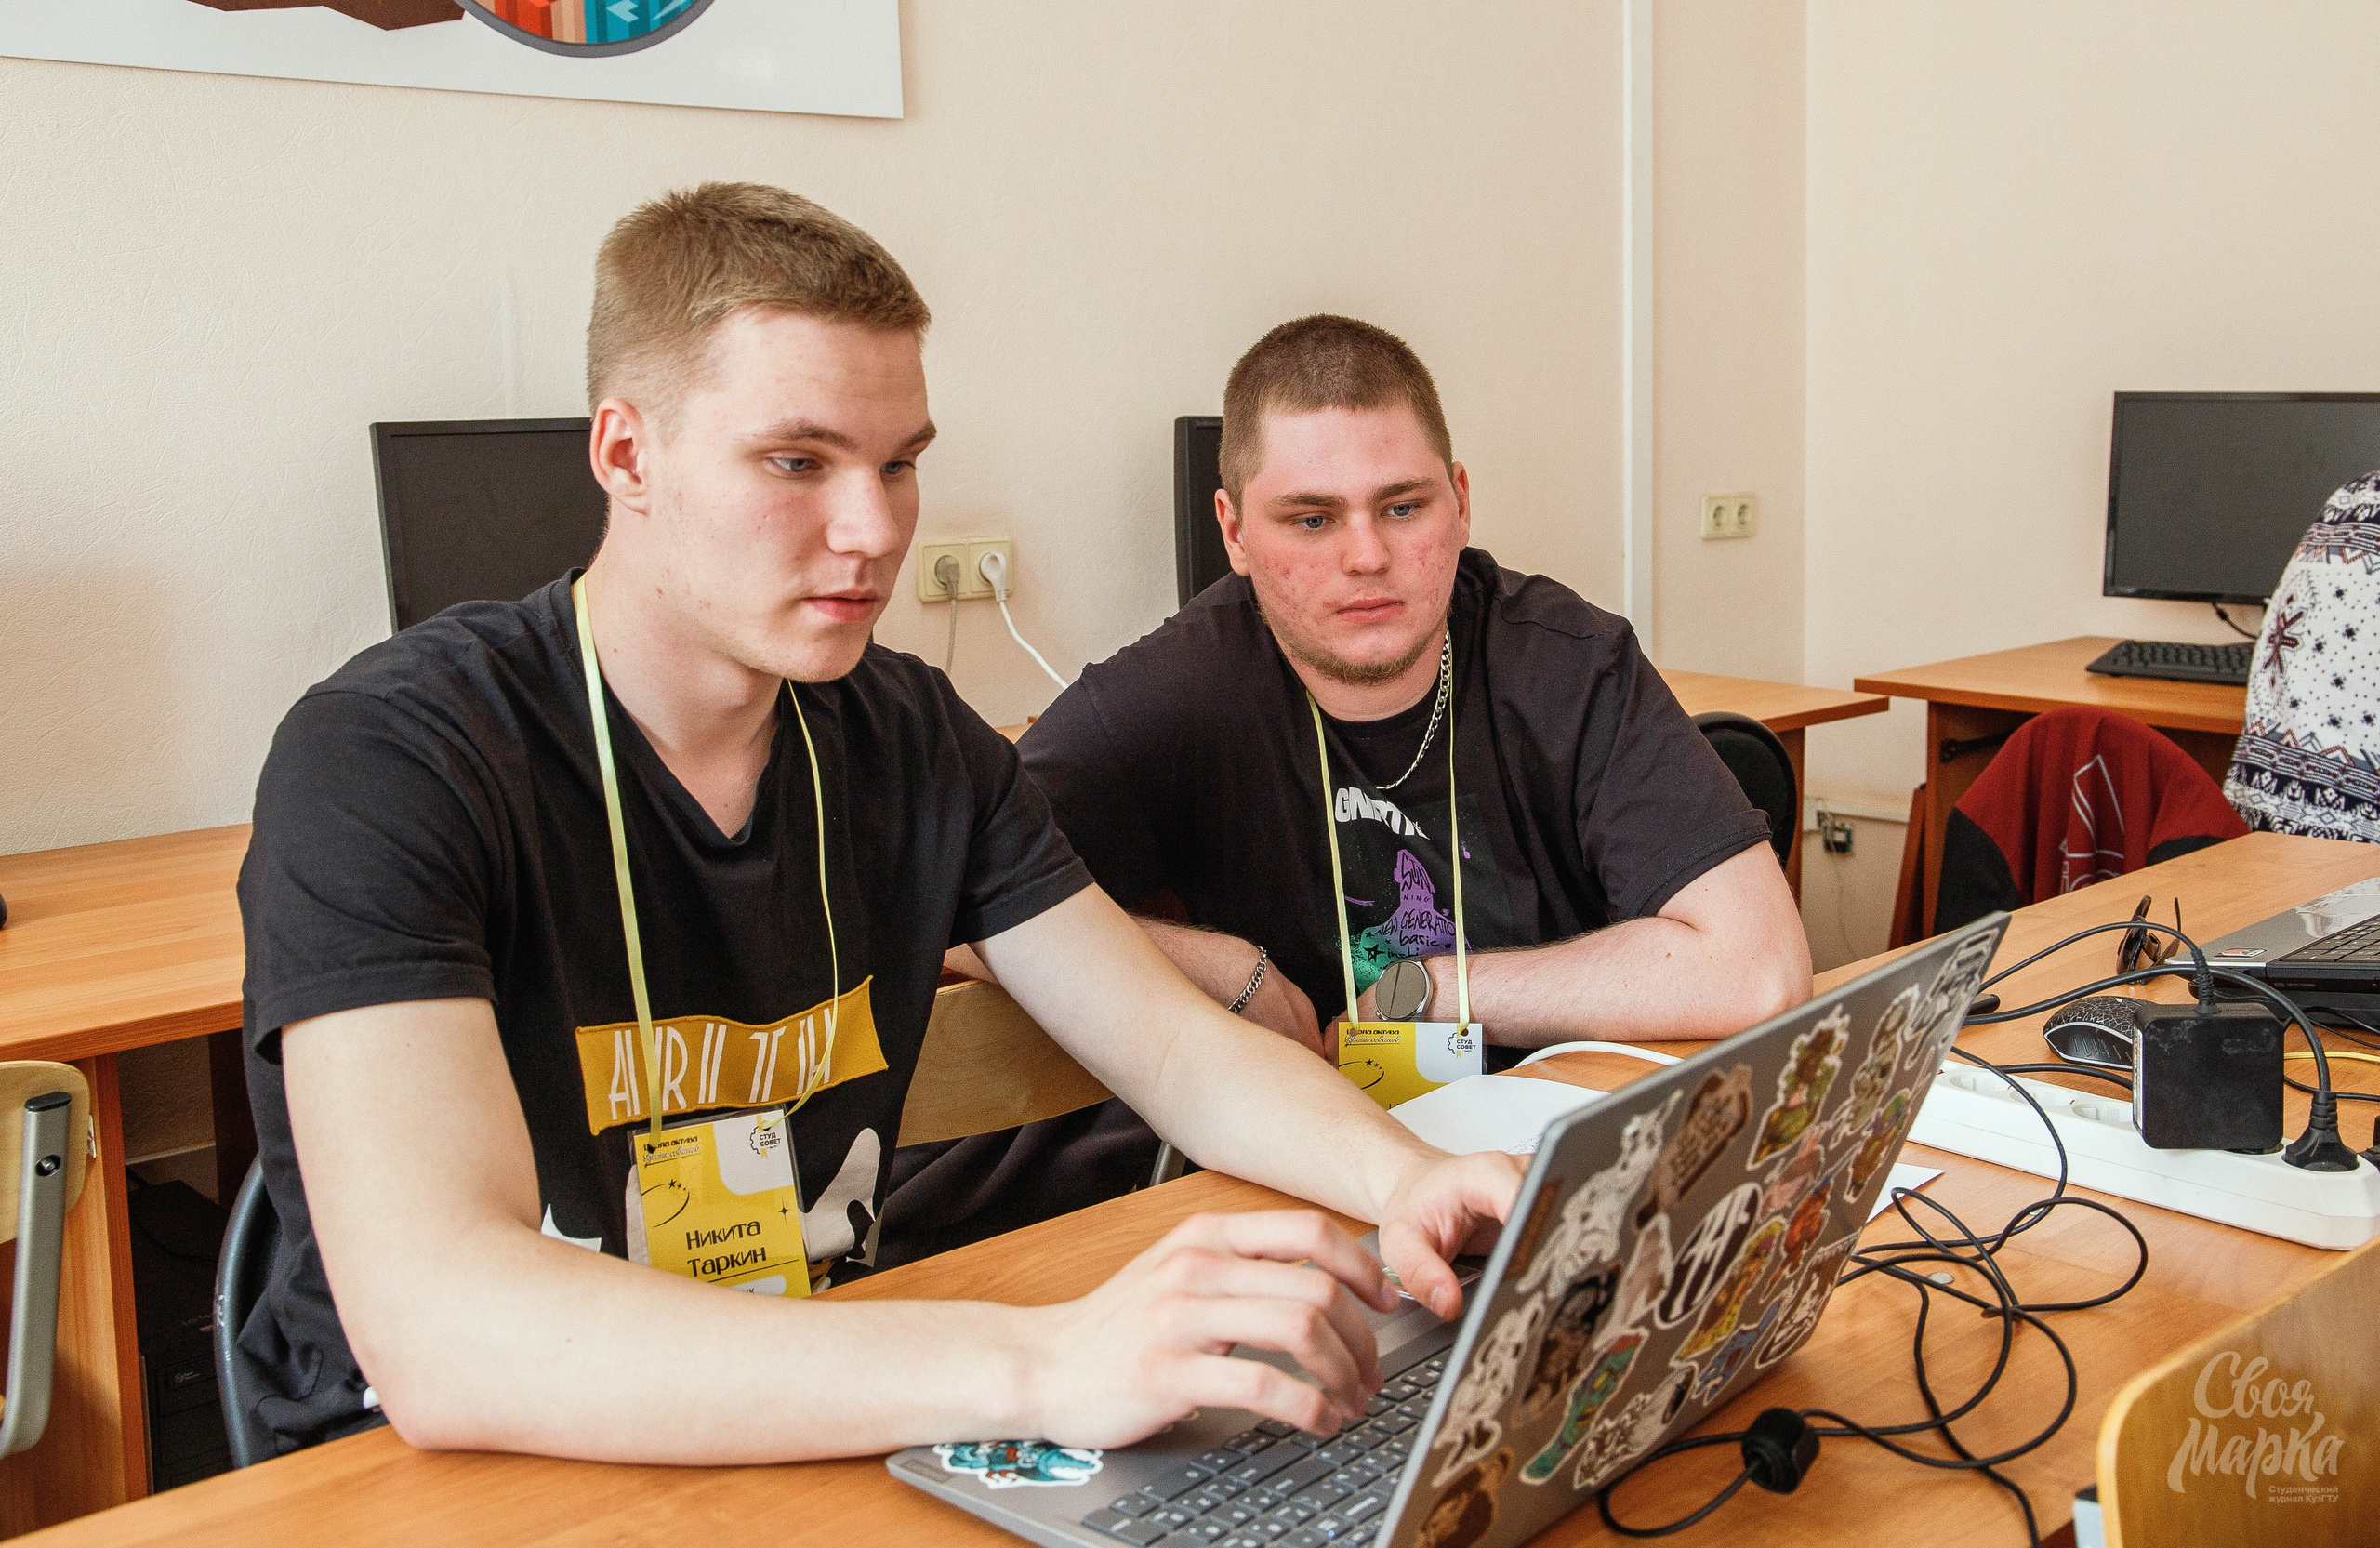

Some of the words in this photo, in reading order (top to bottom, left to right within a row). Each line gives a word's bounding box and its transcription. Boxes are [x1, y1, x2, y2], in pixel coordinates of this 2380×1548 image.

[1403, 894, 1431, 903] NING
[1375, 917, 1398, 936] NEW
[1401, 908, 1456, 936] GENERATIO
[1399, 930, 1441, 946] basic
[760, 1138, 781, 1147] СОВЕТ
[686, 1219, 761, 1250] Никита
[687, 1247, 767, 1278] Таркин
